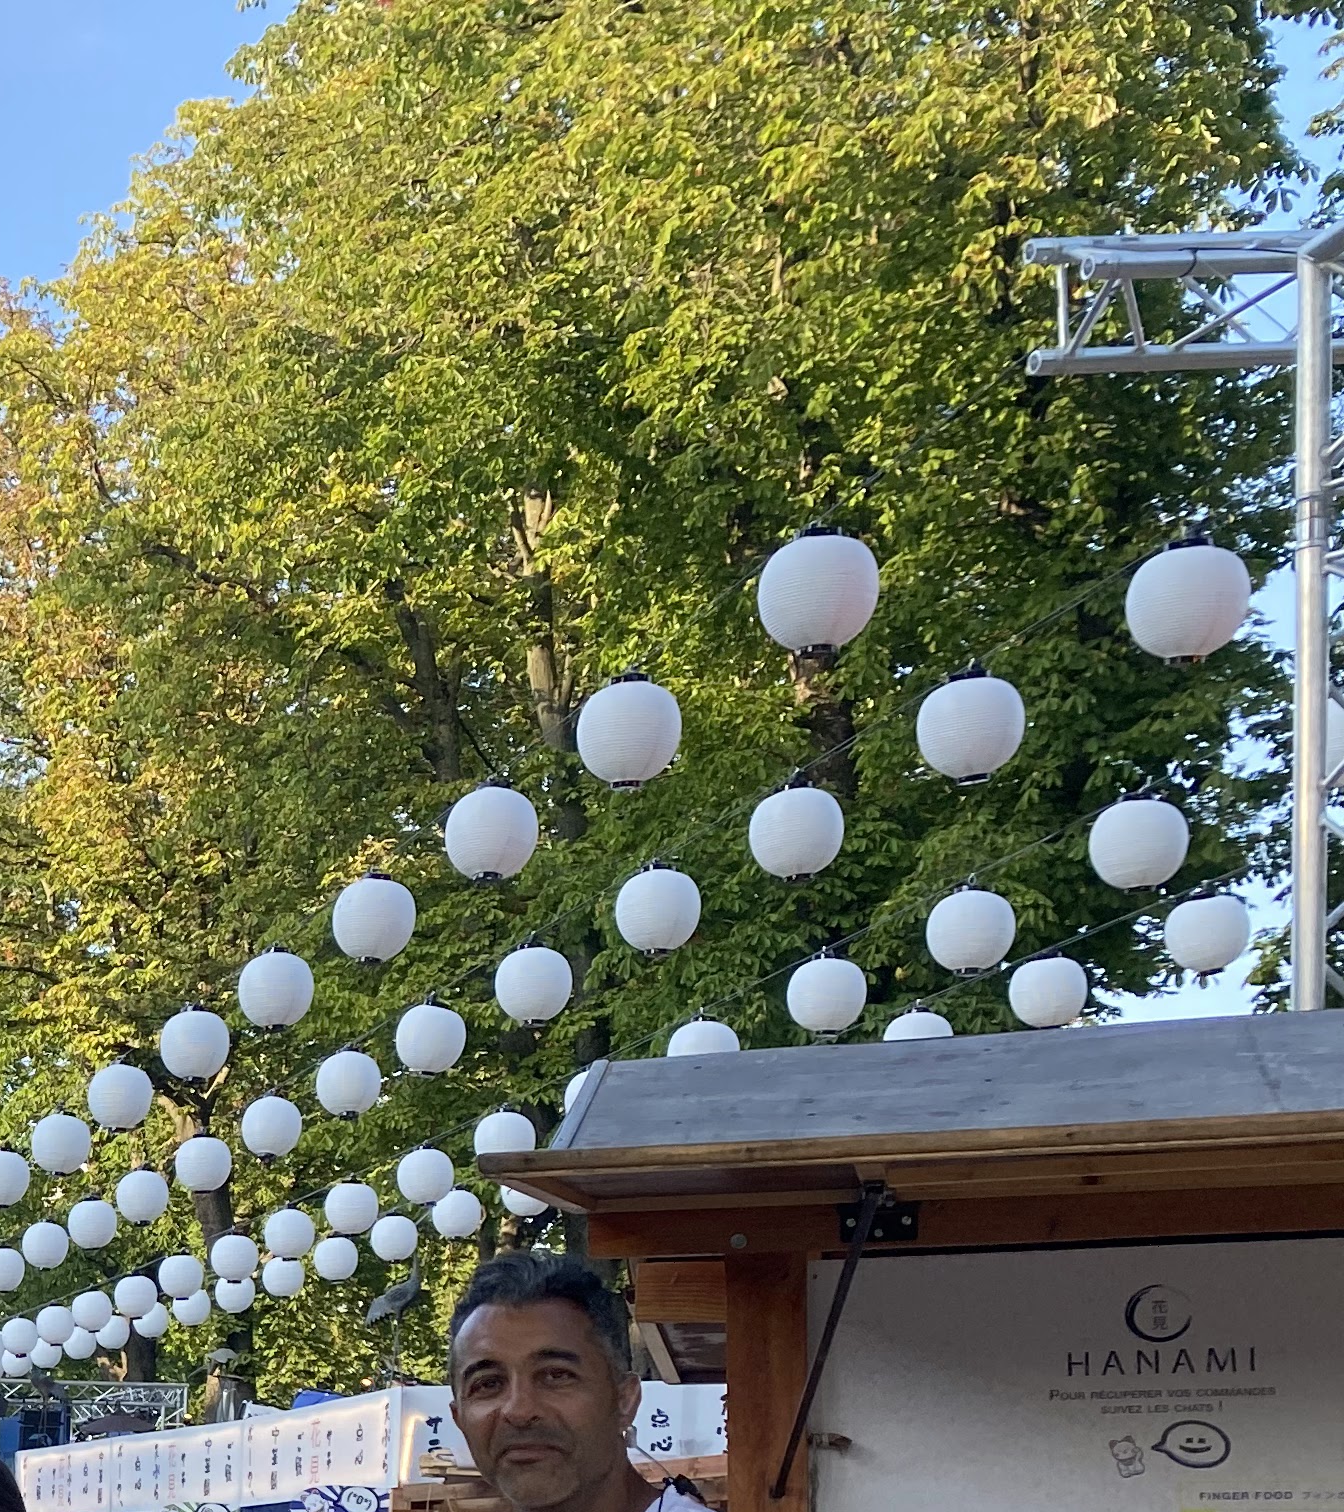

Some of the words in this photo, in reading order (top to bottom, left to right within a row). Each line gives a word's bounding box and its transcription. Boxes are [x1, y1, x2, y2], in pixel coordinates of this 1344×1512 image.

[1067, 1347, 1255, 1376] HANAMI
[1101, 1405, 1142, 1414] SUIVEZ
[1148, 1404, 1169, 1413] LES
[1199, 1491, 1249, 1500] FINGER
[1255, 1491, 1293, 1500] FOOD
